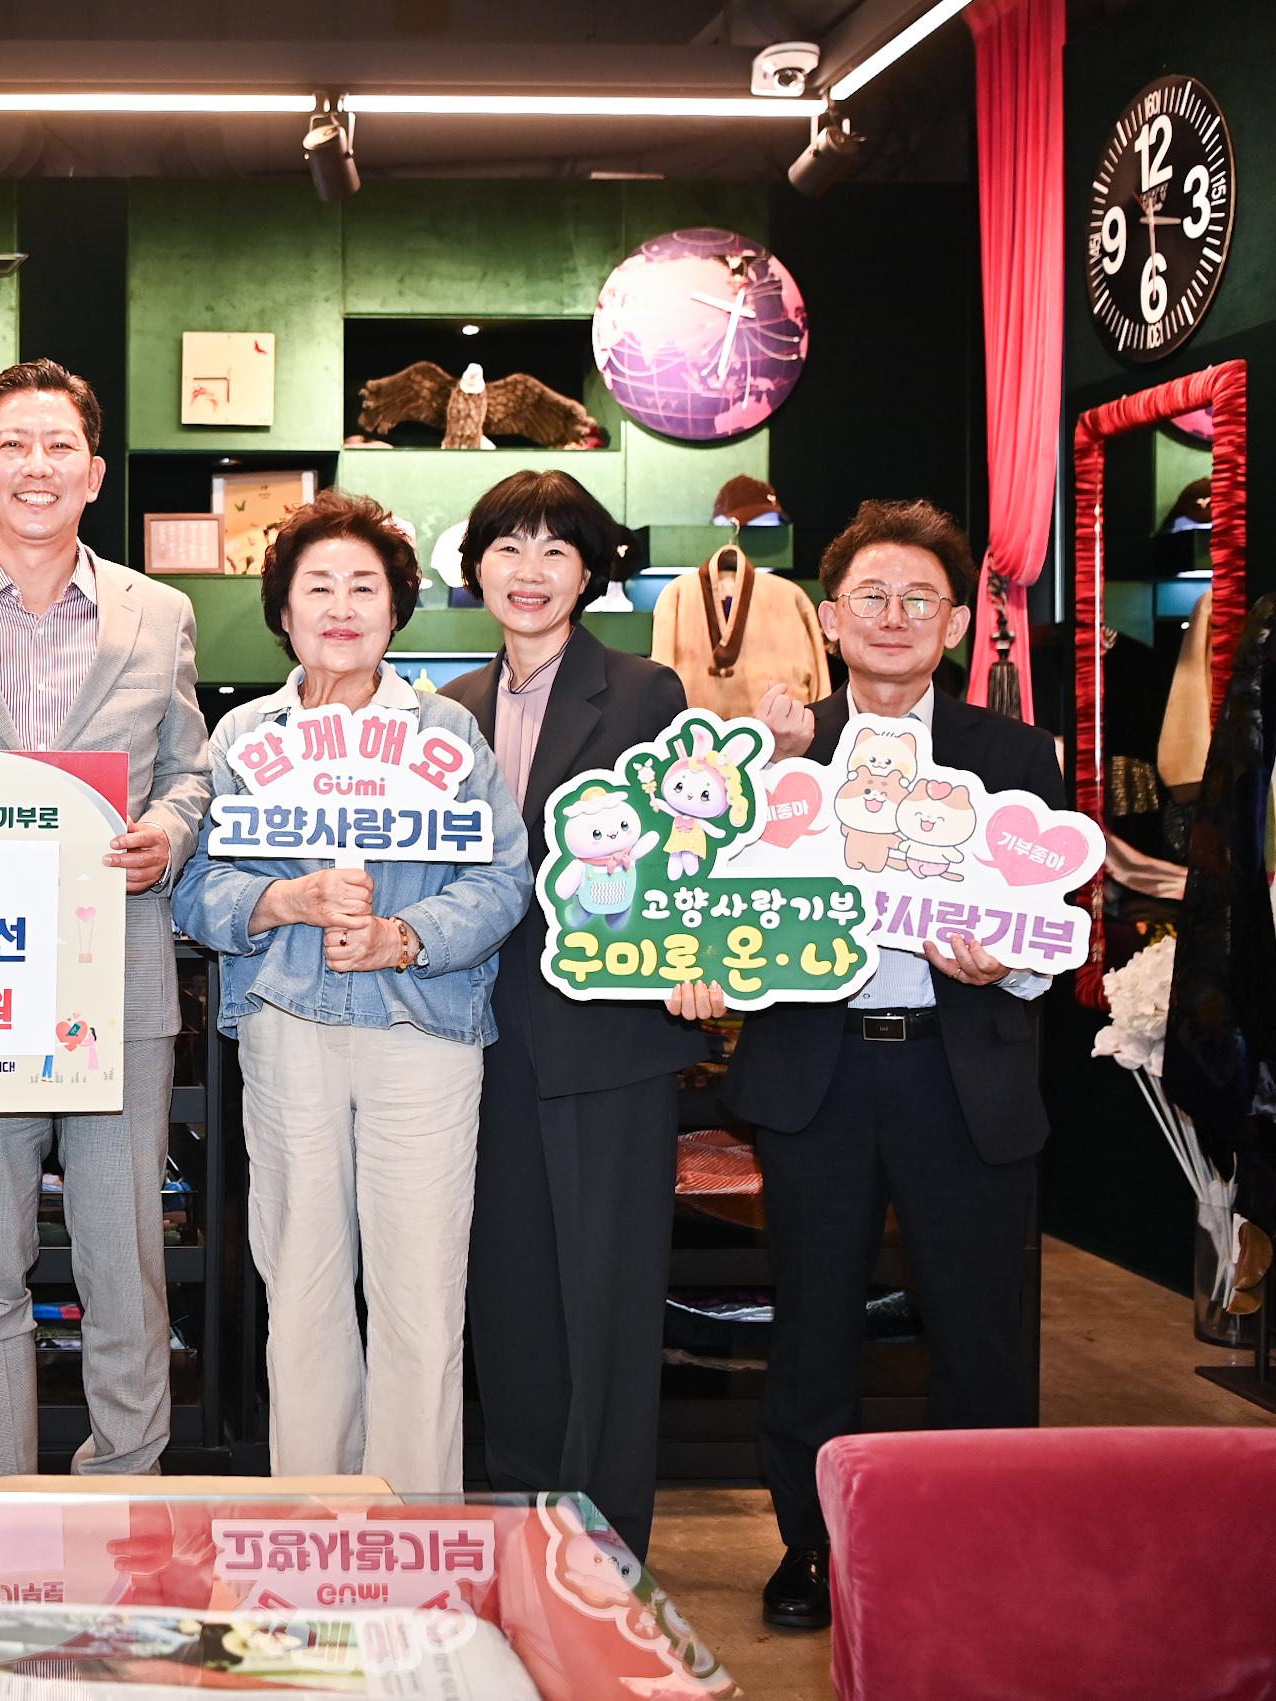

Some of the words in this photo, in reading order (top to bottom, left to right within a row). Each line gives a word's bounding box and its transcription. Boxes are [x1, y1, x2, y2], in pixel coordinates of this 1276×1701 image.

[1134, 114, 1173, 193] 12
[1183, 165, 1212, 239] 3
[1101, 205, 1126, 275] 9
[1140, 252, 1168, 324] 6
[237, 713, 464, 792] 함께해요
[219, 805, 483, 851] 고향사랑기부
[996, 831, 1067, 872] 기부좋아
[641, 886, 858, 929] 고향사랑기부
[558, 931, 704, 982] 구미로
